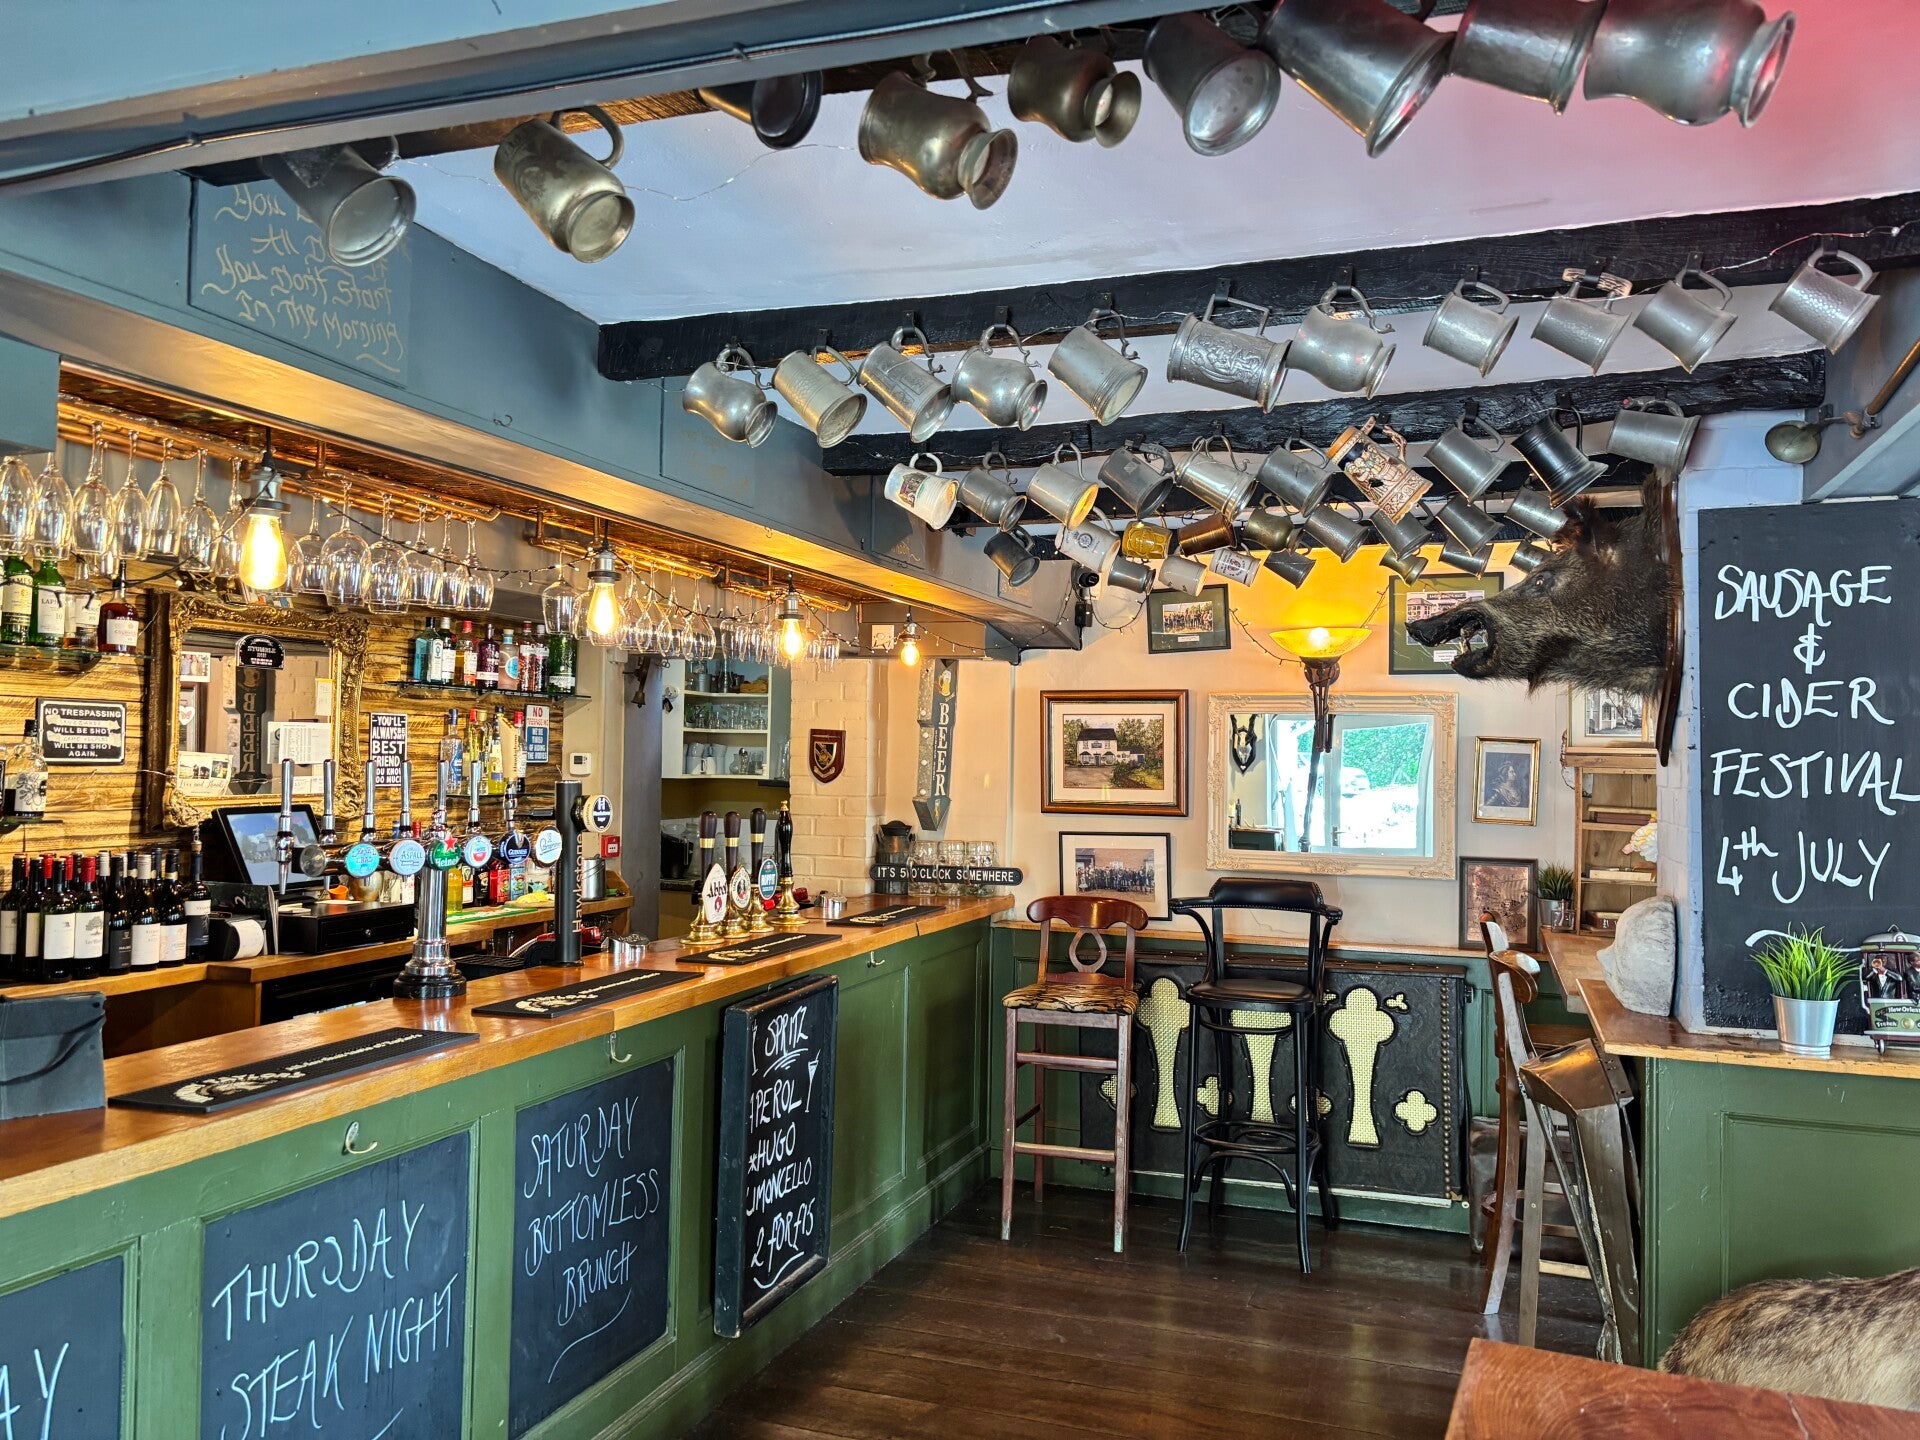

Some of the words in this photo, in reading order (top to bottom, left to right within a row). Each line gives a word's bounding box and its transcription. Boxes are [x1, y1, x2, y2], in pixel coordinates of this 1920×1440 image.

[201, 244, 268, 296] You
[1714, 564, 1892, 627] SAUSAGE
[45, 708, 59, 716] NO
[60, 708, 122, 718] TRESPASSING
[53, 726, 75, 734] WILL
[372, 726, 398, 740] ALWAYS
[377, 715, 402, 727] YOU'LL
[532, 706, 543, 718] NO
[1727, 676, 1895, 729] CIDER
[372, 740, 405, 755] BEST
[934, 702, 950, 797] BEER
[1710, 748, 1920, 815] FESTIVAL
[571, 833, 583, 933] Hawkstone
[877, 866, 896, 878] IT'S
[899, 867, 906, 878] 5
[911, 867, 951, 880] O'CLOCK
[956, 870, 1014, 882] SOMEWHERE
[1716, 825, 1779, 896] 4th
[1771, 830, 1891, 904] JULY
[764, 1005, 809, 1057] SPRITZ
[524, 1096, 639, 1199] SATURDAY
[525, 1168, 660, 1277] BOTTOMLESS
[751, 1226, 765, 1268] 2
[767, 1210, 794, 1273] FOR
[211, 1199, 425, 1342] THURSDAY
[557, 1241, 638, 1327] BRUNCH
[220, 1314, 354, 1440] STEAK
[364, 1272, 459, 1384] NIGHT
